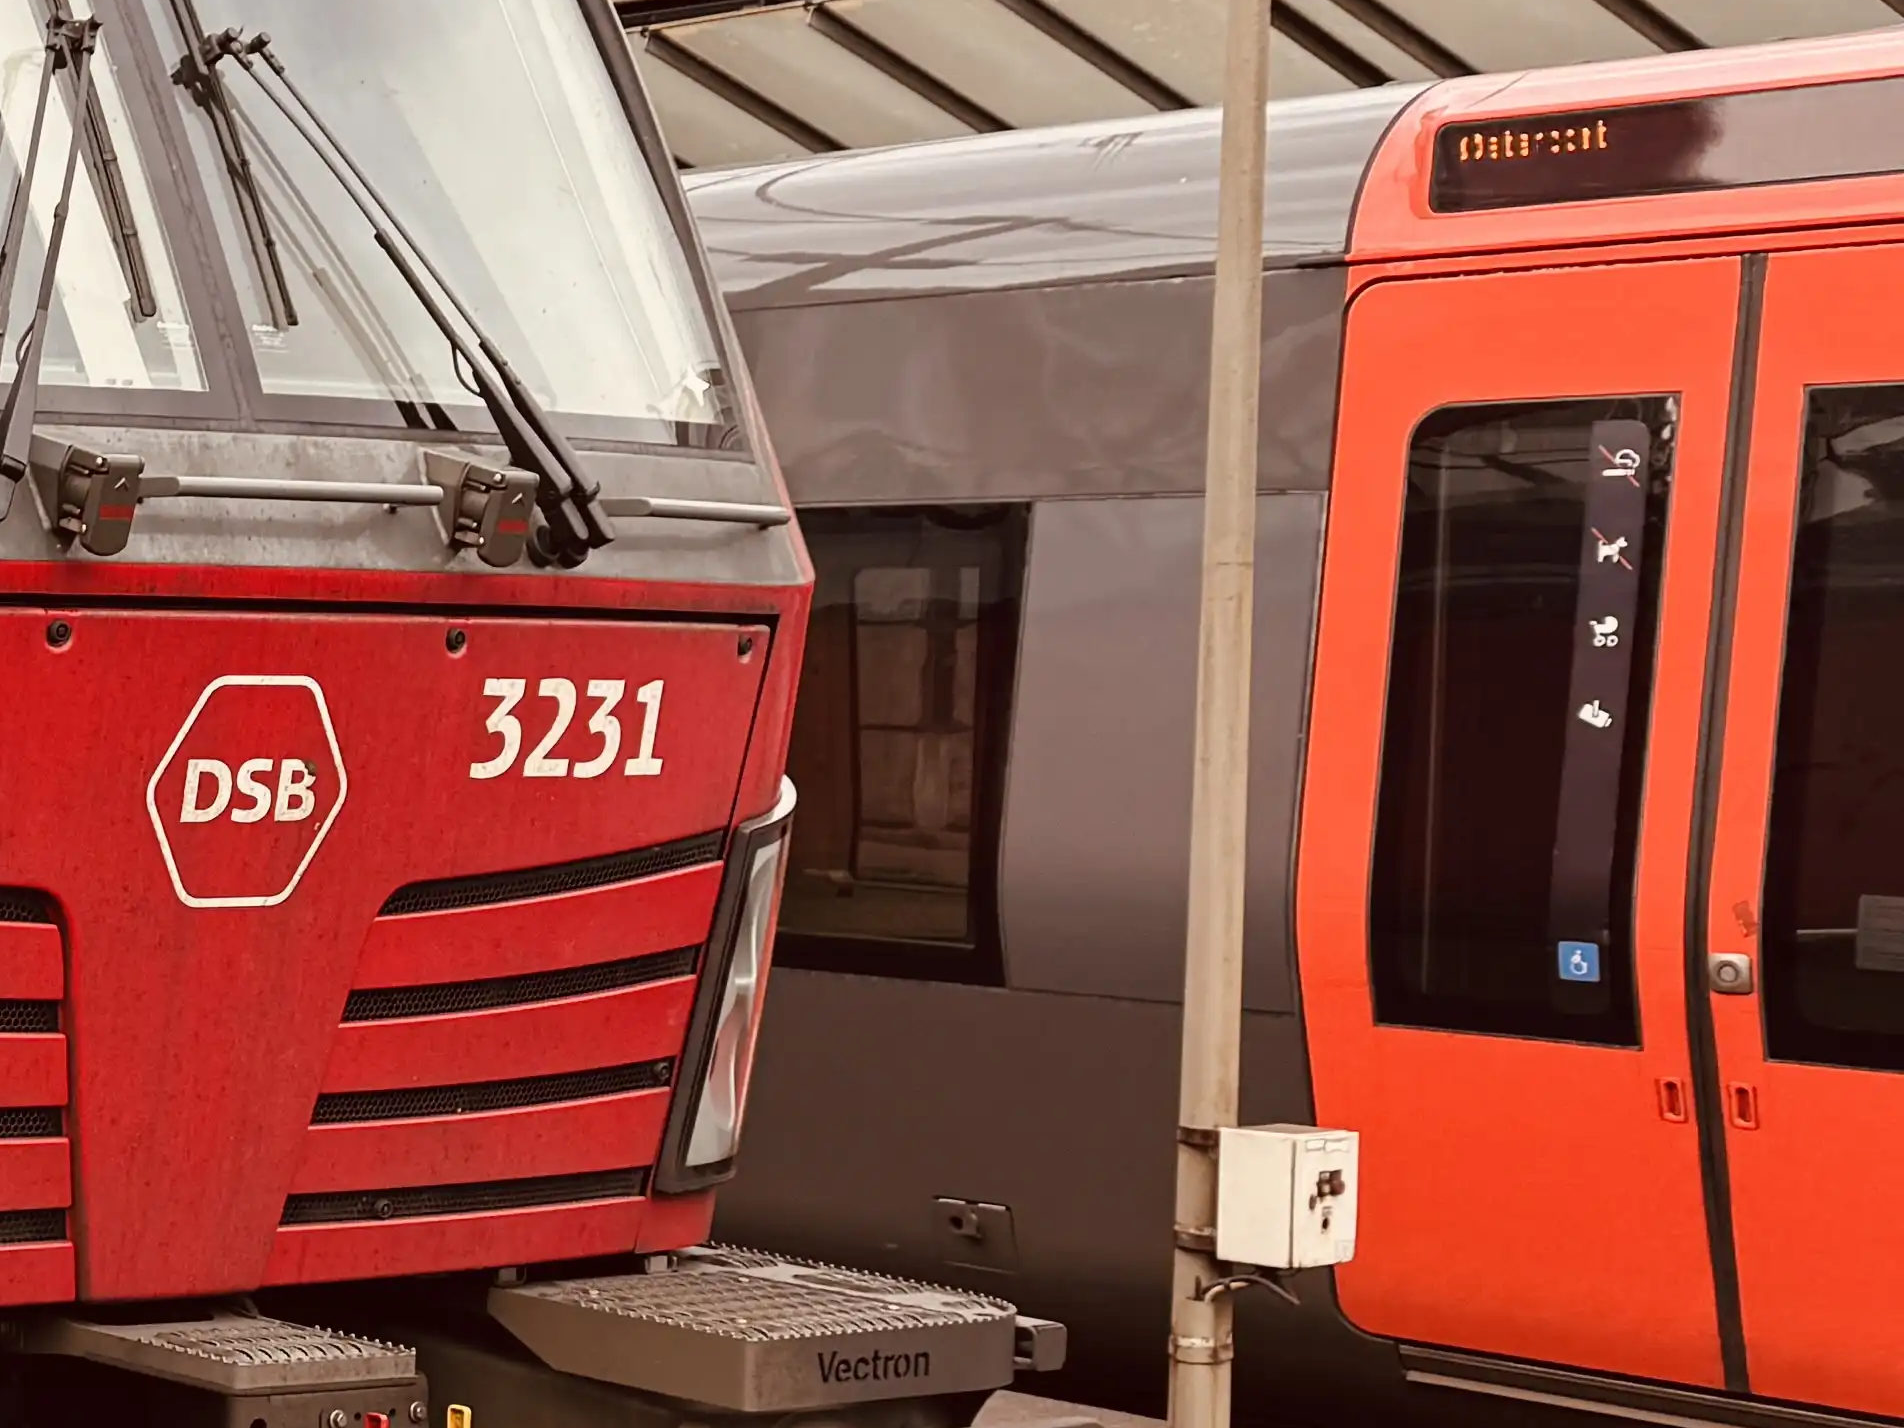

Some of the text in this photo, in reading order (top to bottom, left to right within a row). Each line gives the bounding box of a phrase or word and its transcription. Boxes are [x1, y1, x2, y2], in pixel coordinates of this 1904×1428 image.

[469, 678, 665, 780] 3231
[179, 759, 317, 824] DSB
[817, 1349, 930, 1384] Vectron
